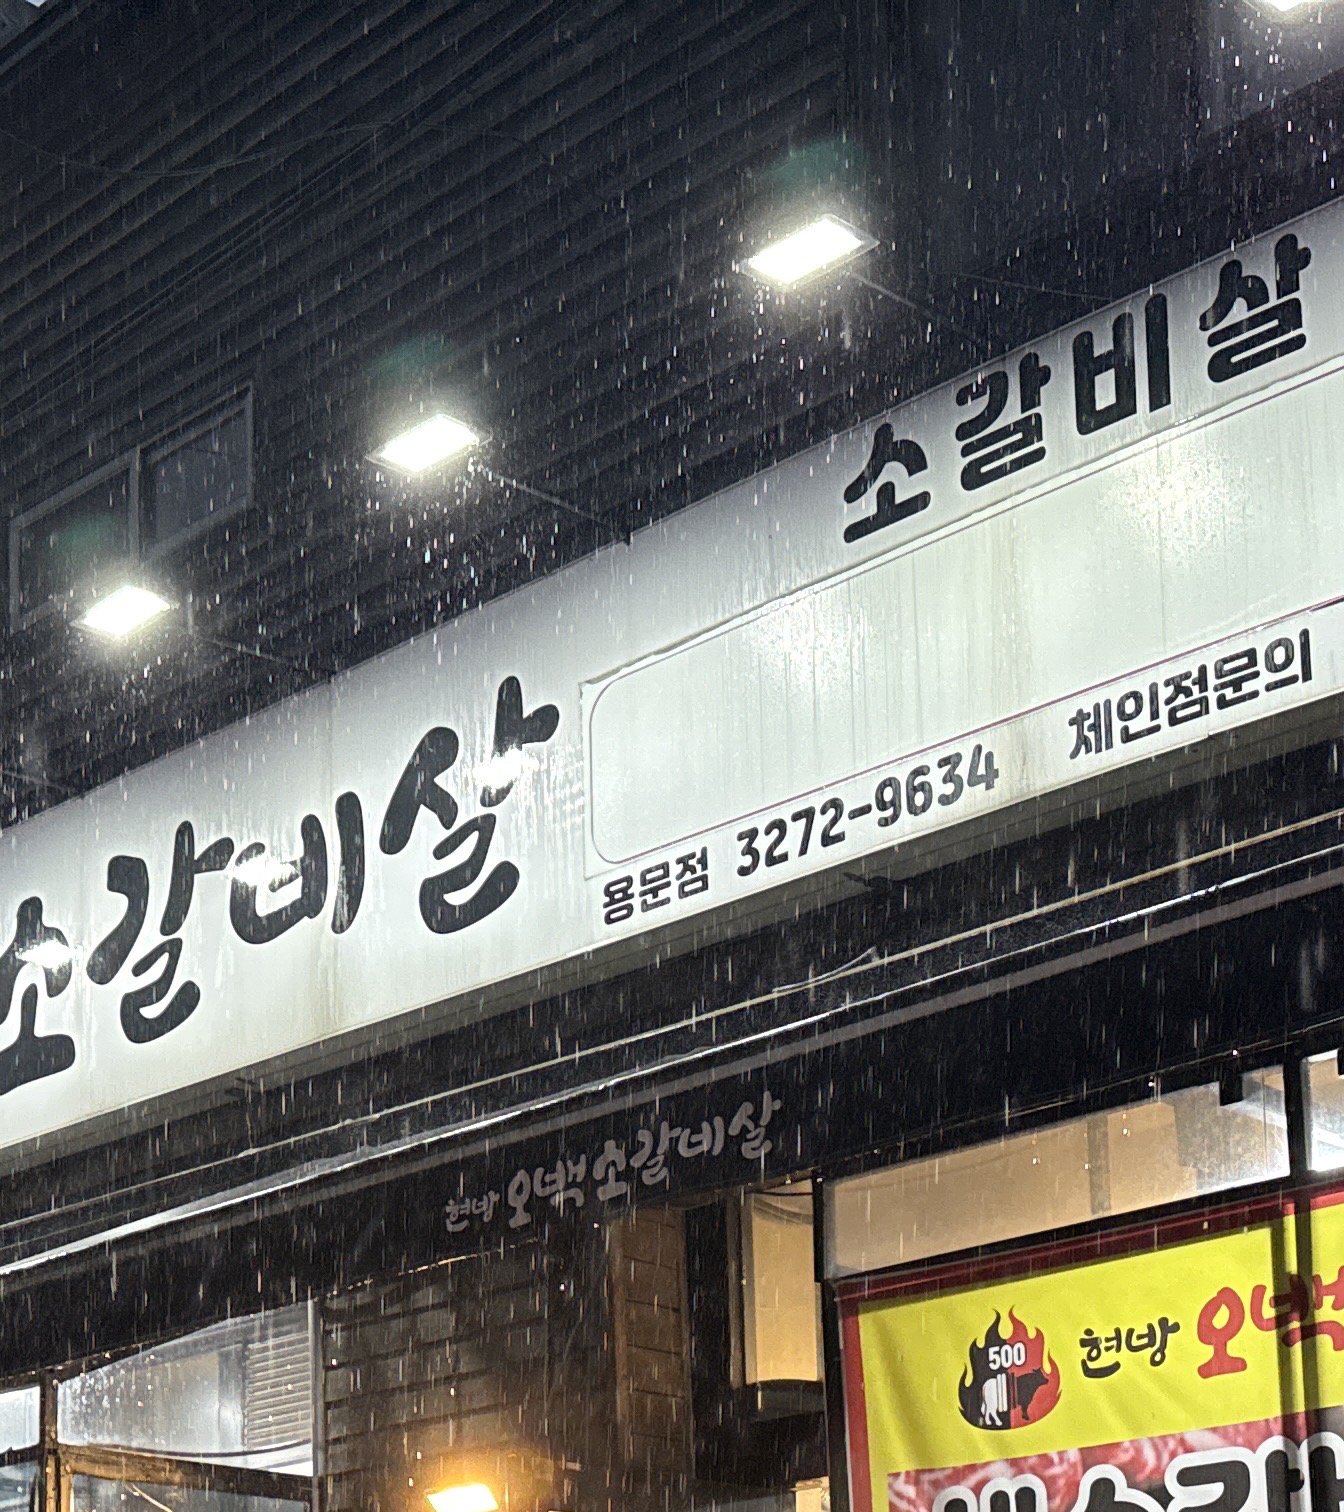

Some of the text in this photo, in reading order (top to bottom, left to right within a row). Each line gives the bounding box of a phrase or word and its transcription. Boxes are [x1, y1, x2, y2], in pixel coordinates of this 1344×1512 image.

[841, 232, 1313, 545] 소갈비살
[602, 845, 710, 926] 용문점
[735, 744, 1000, 879] 3272-9634
[1067, 628, 1315, 761] 체인점문의
[592, 1090, 783, 1201] 소갈비살
[988, 1341, 1026, 1371] 500
[1079, 1315, 1181, 1379] 현방
